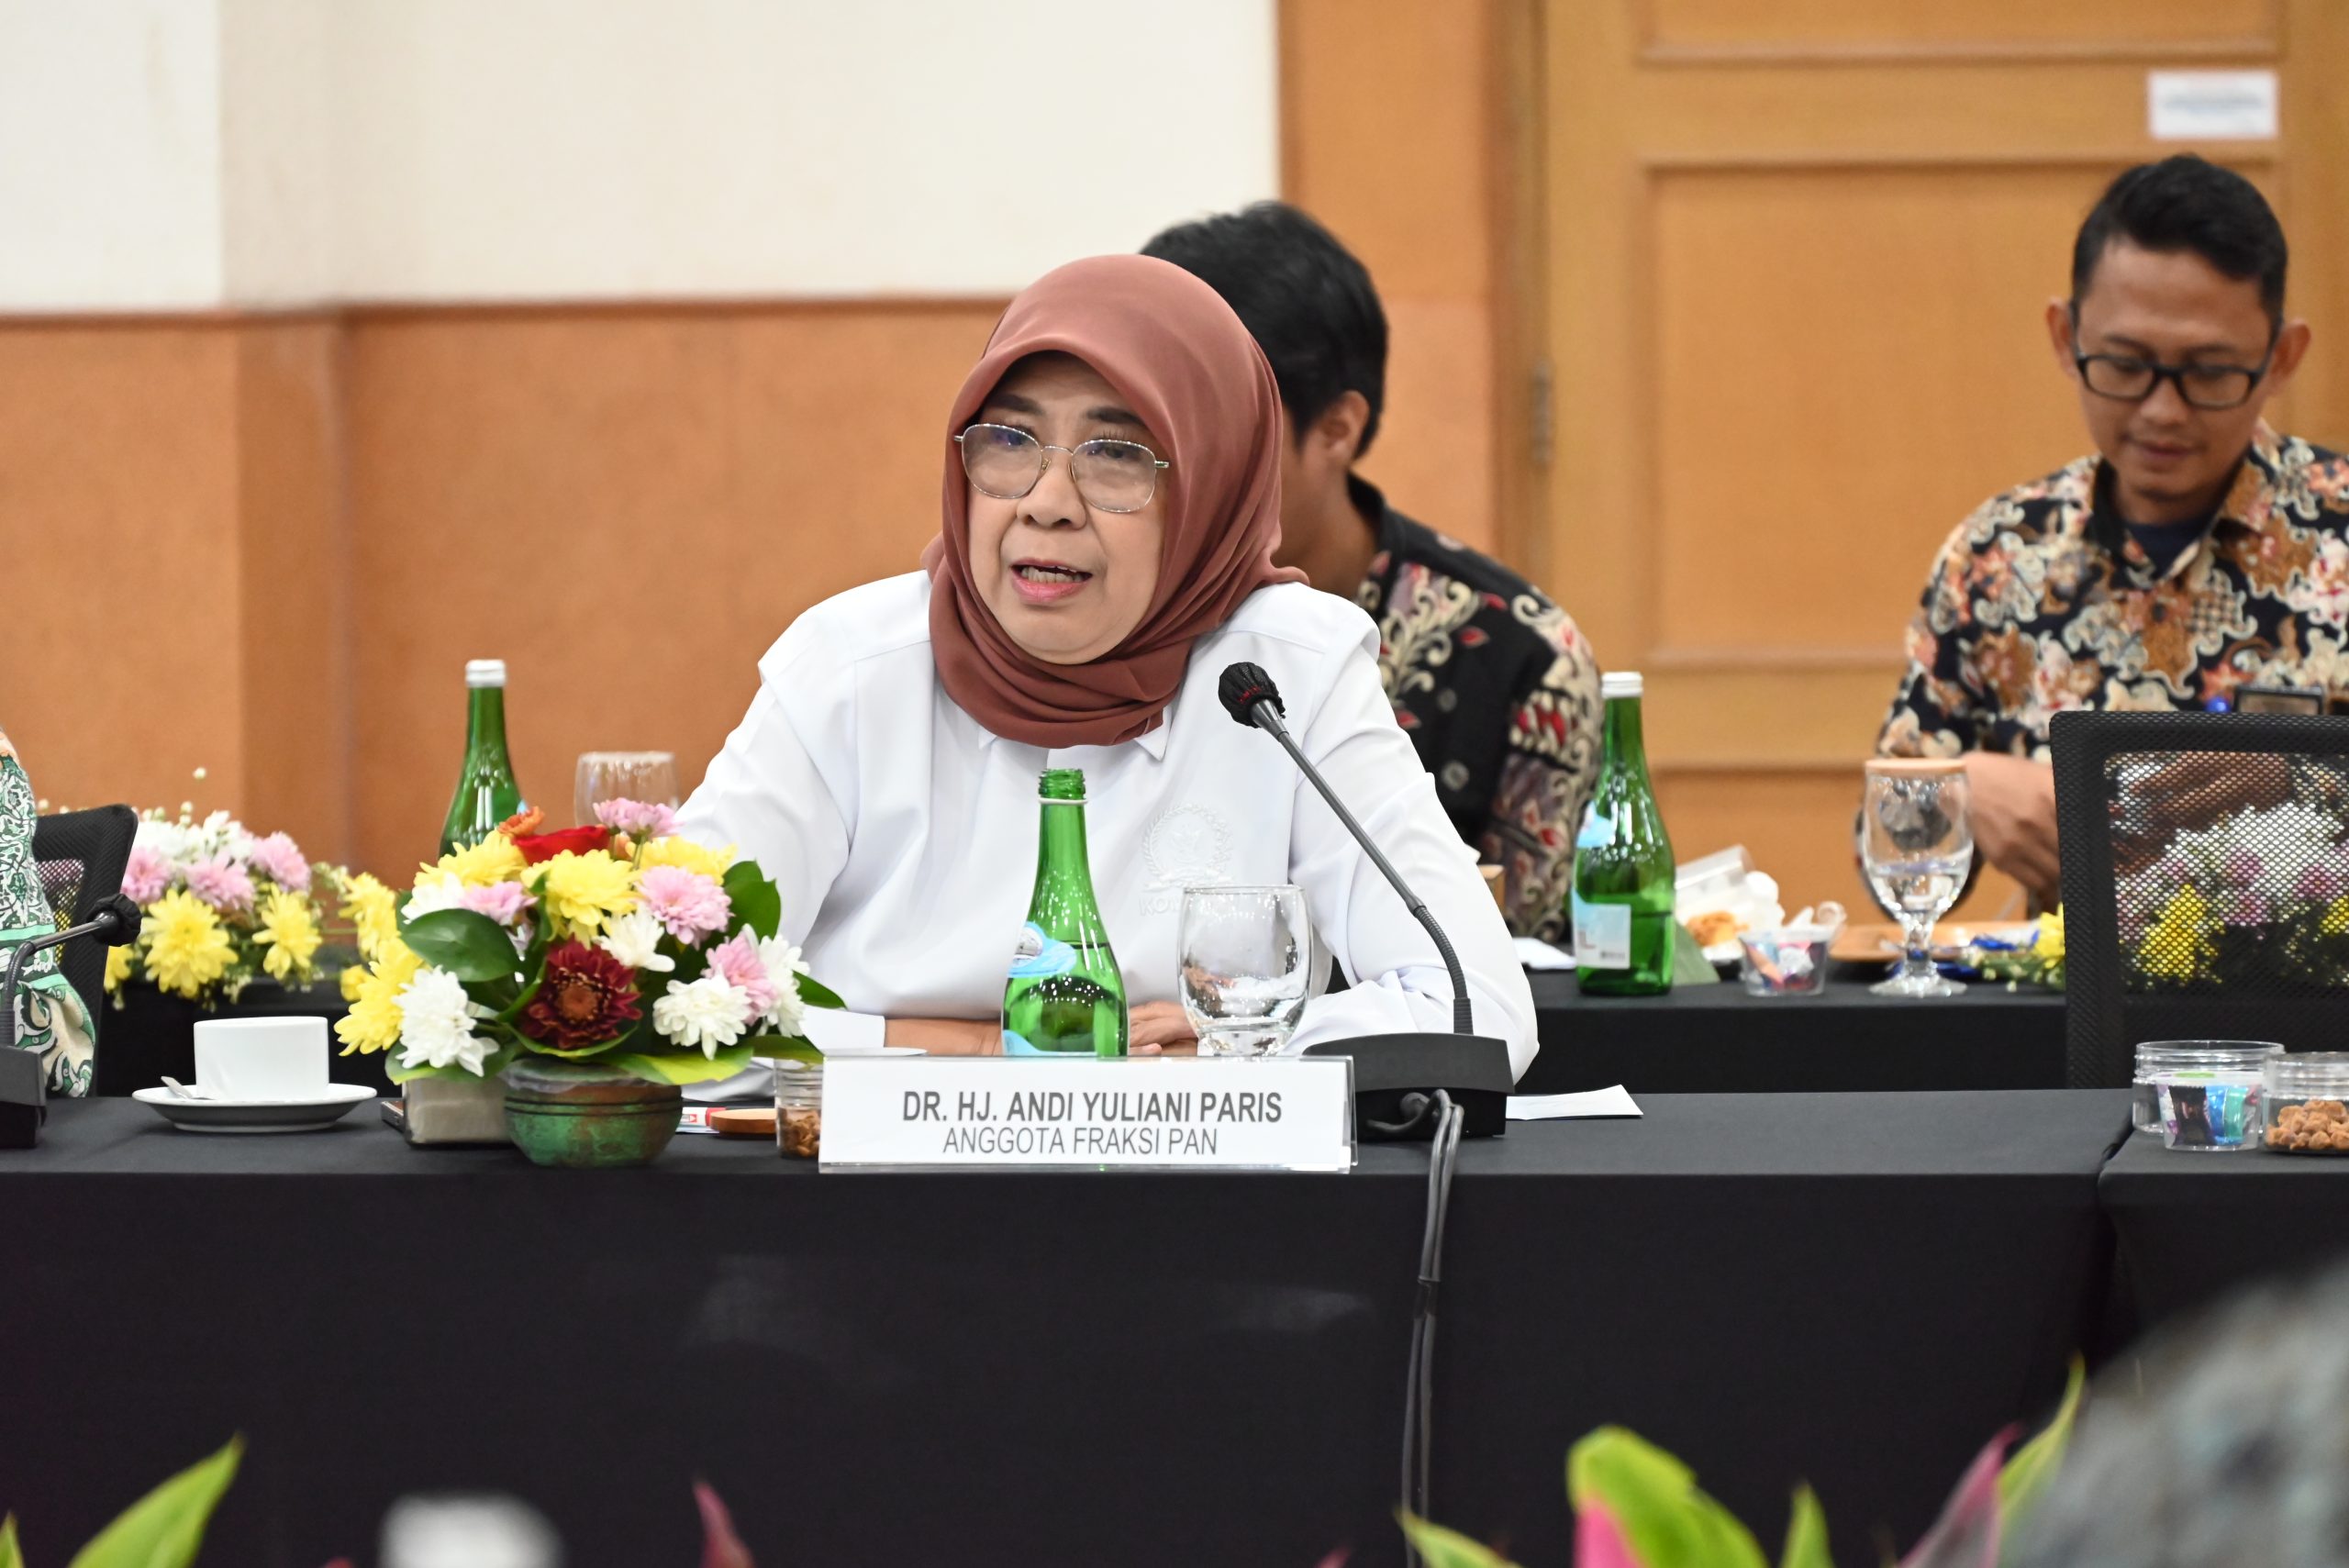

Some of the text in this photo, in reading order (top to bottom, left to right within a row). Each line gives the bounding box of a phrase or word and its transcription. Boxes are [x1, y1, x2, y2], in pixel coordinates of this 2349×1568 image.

[904, 1092, 1282, 1122] DR. HJ. ANDI YULIANI PARIS
[943, 1127, 1218, 1154] ANGGOTA FRAKSI PAN
